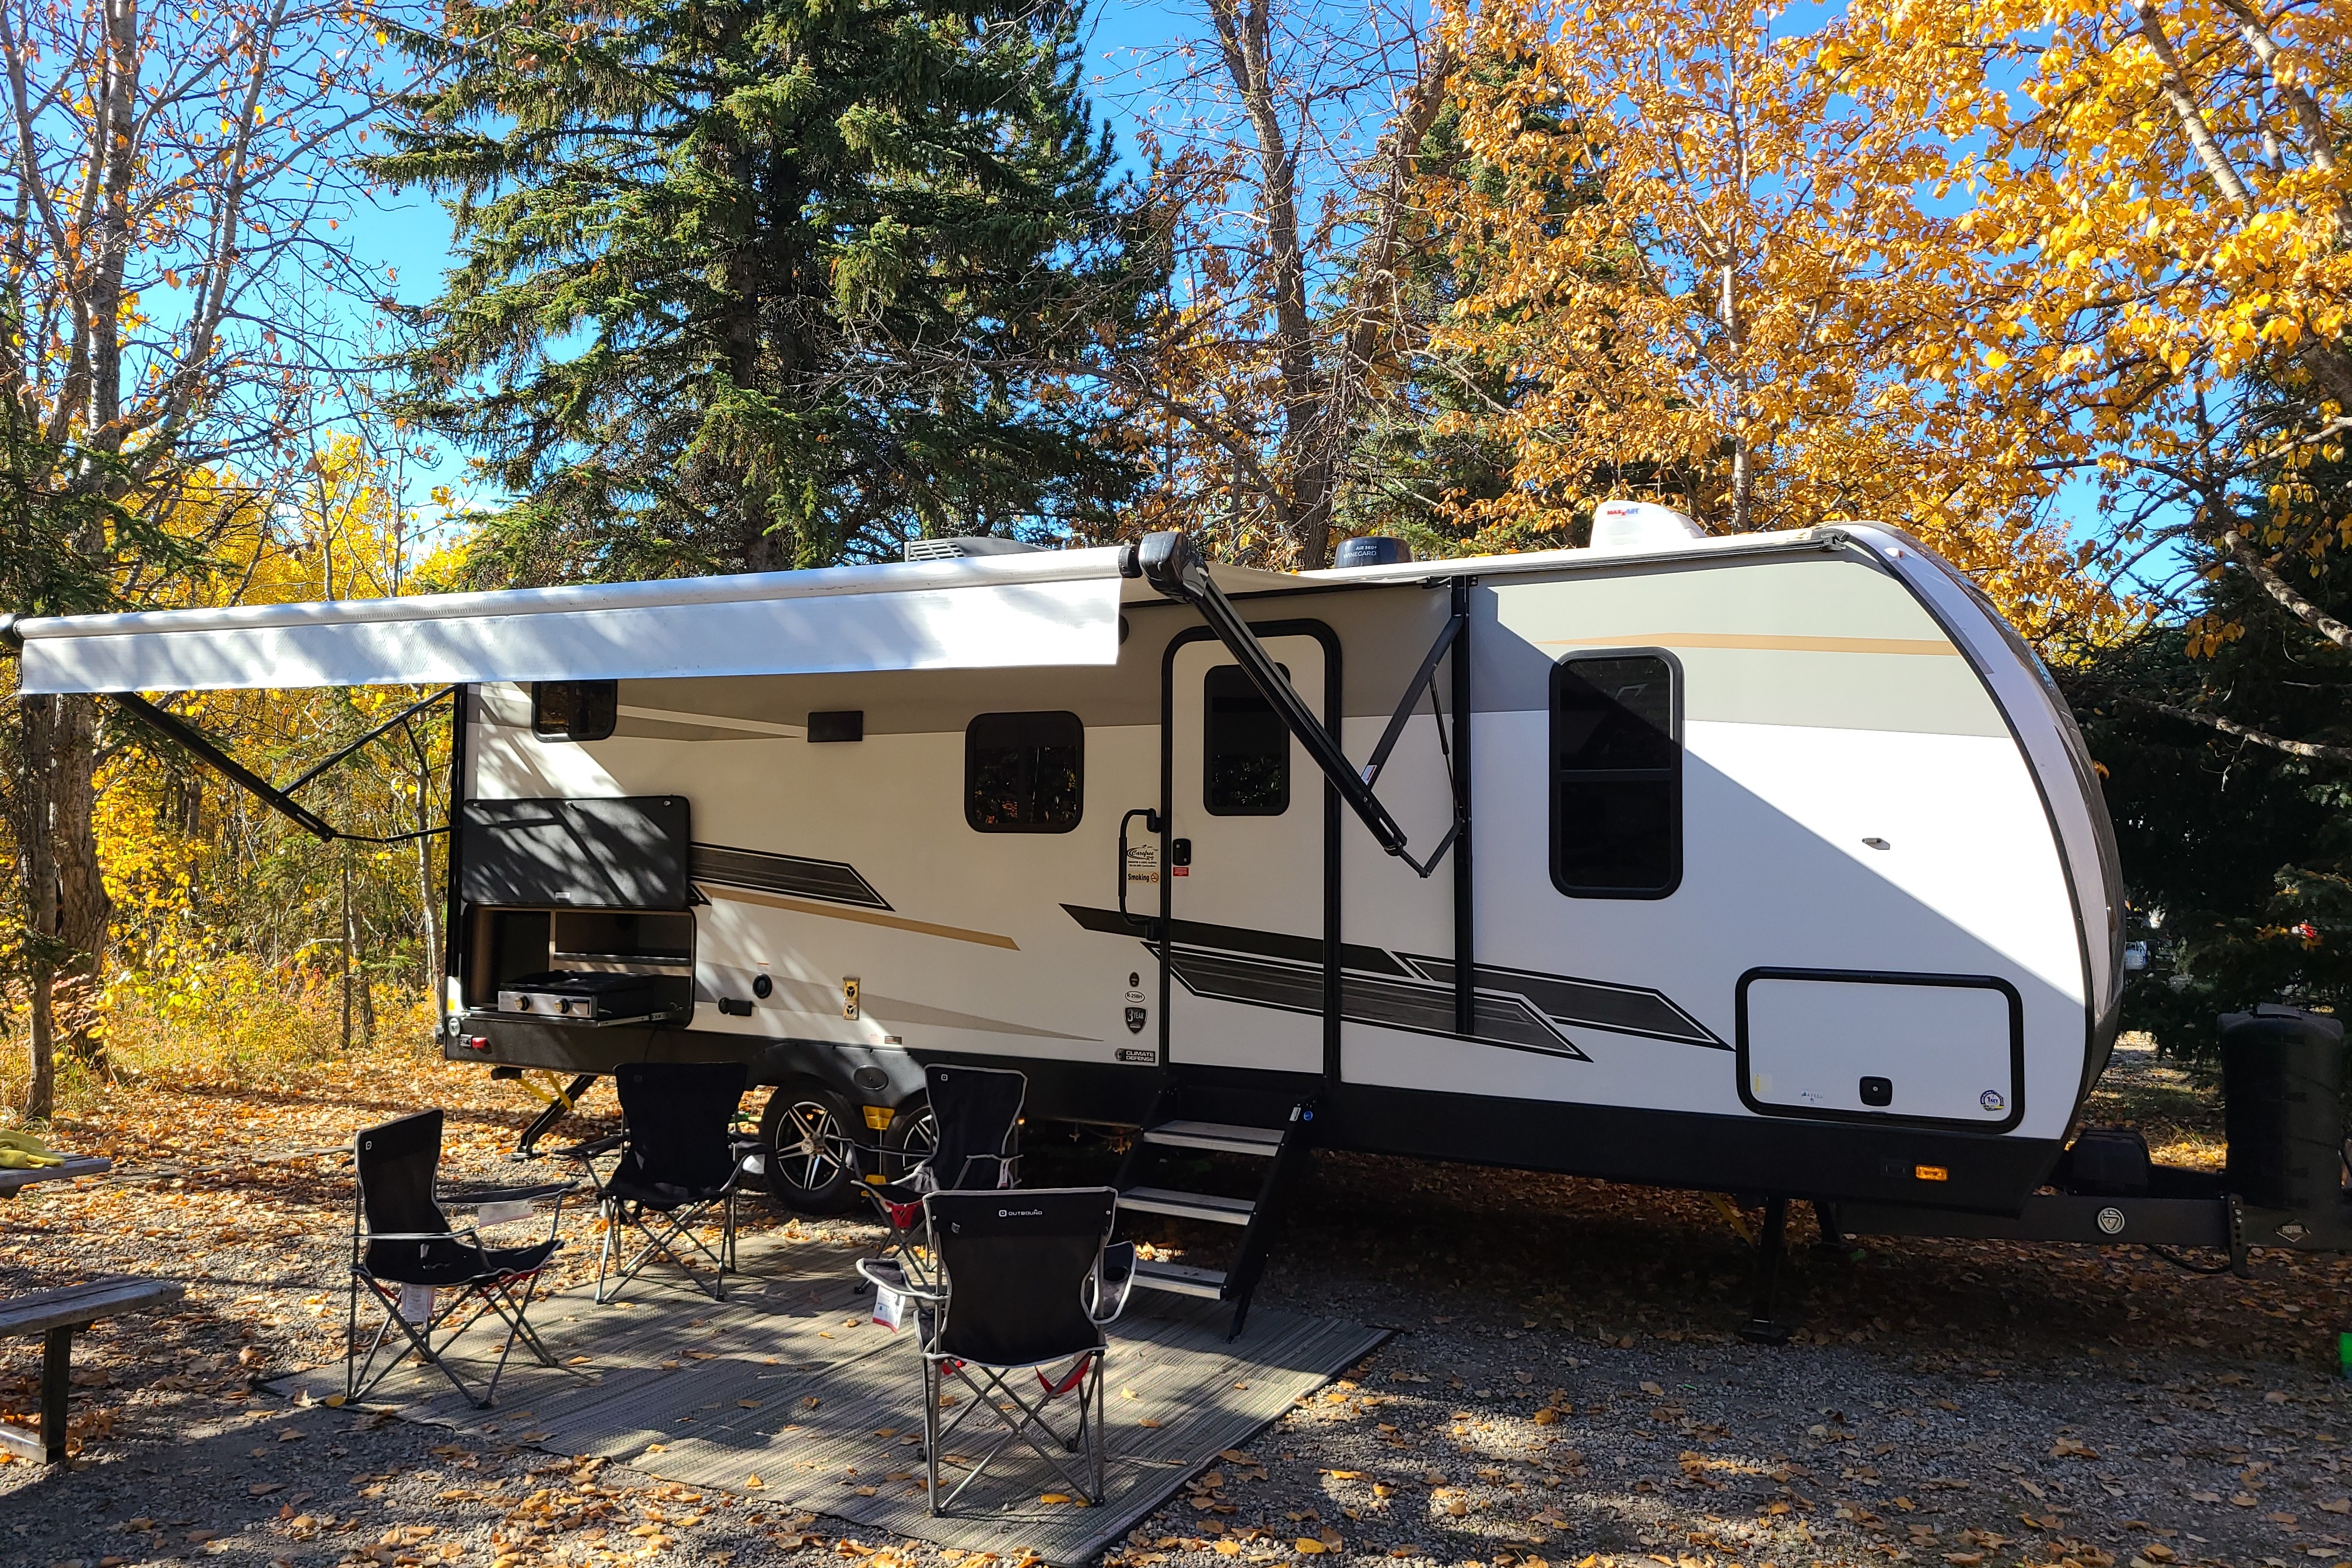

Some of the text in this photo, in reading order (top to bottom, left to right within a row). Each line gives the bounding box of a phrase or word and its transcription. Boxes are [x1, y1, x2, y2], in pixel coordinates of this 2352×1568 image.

[1128, 873, 1150, 882] Smoking
[1127, 1009, 1144, 1022] 3 YEAR
